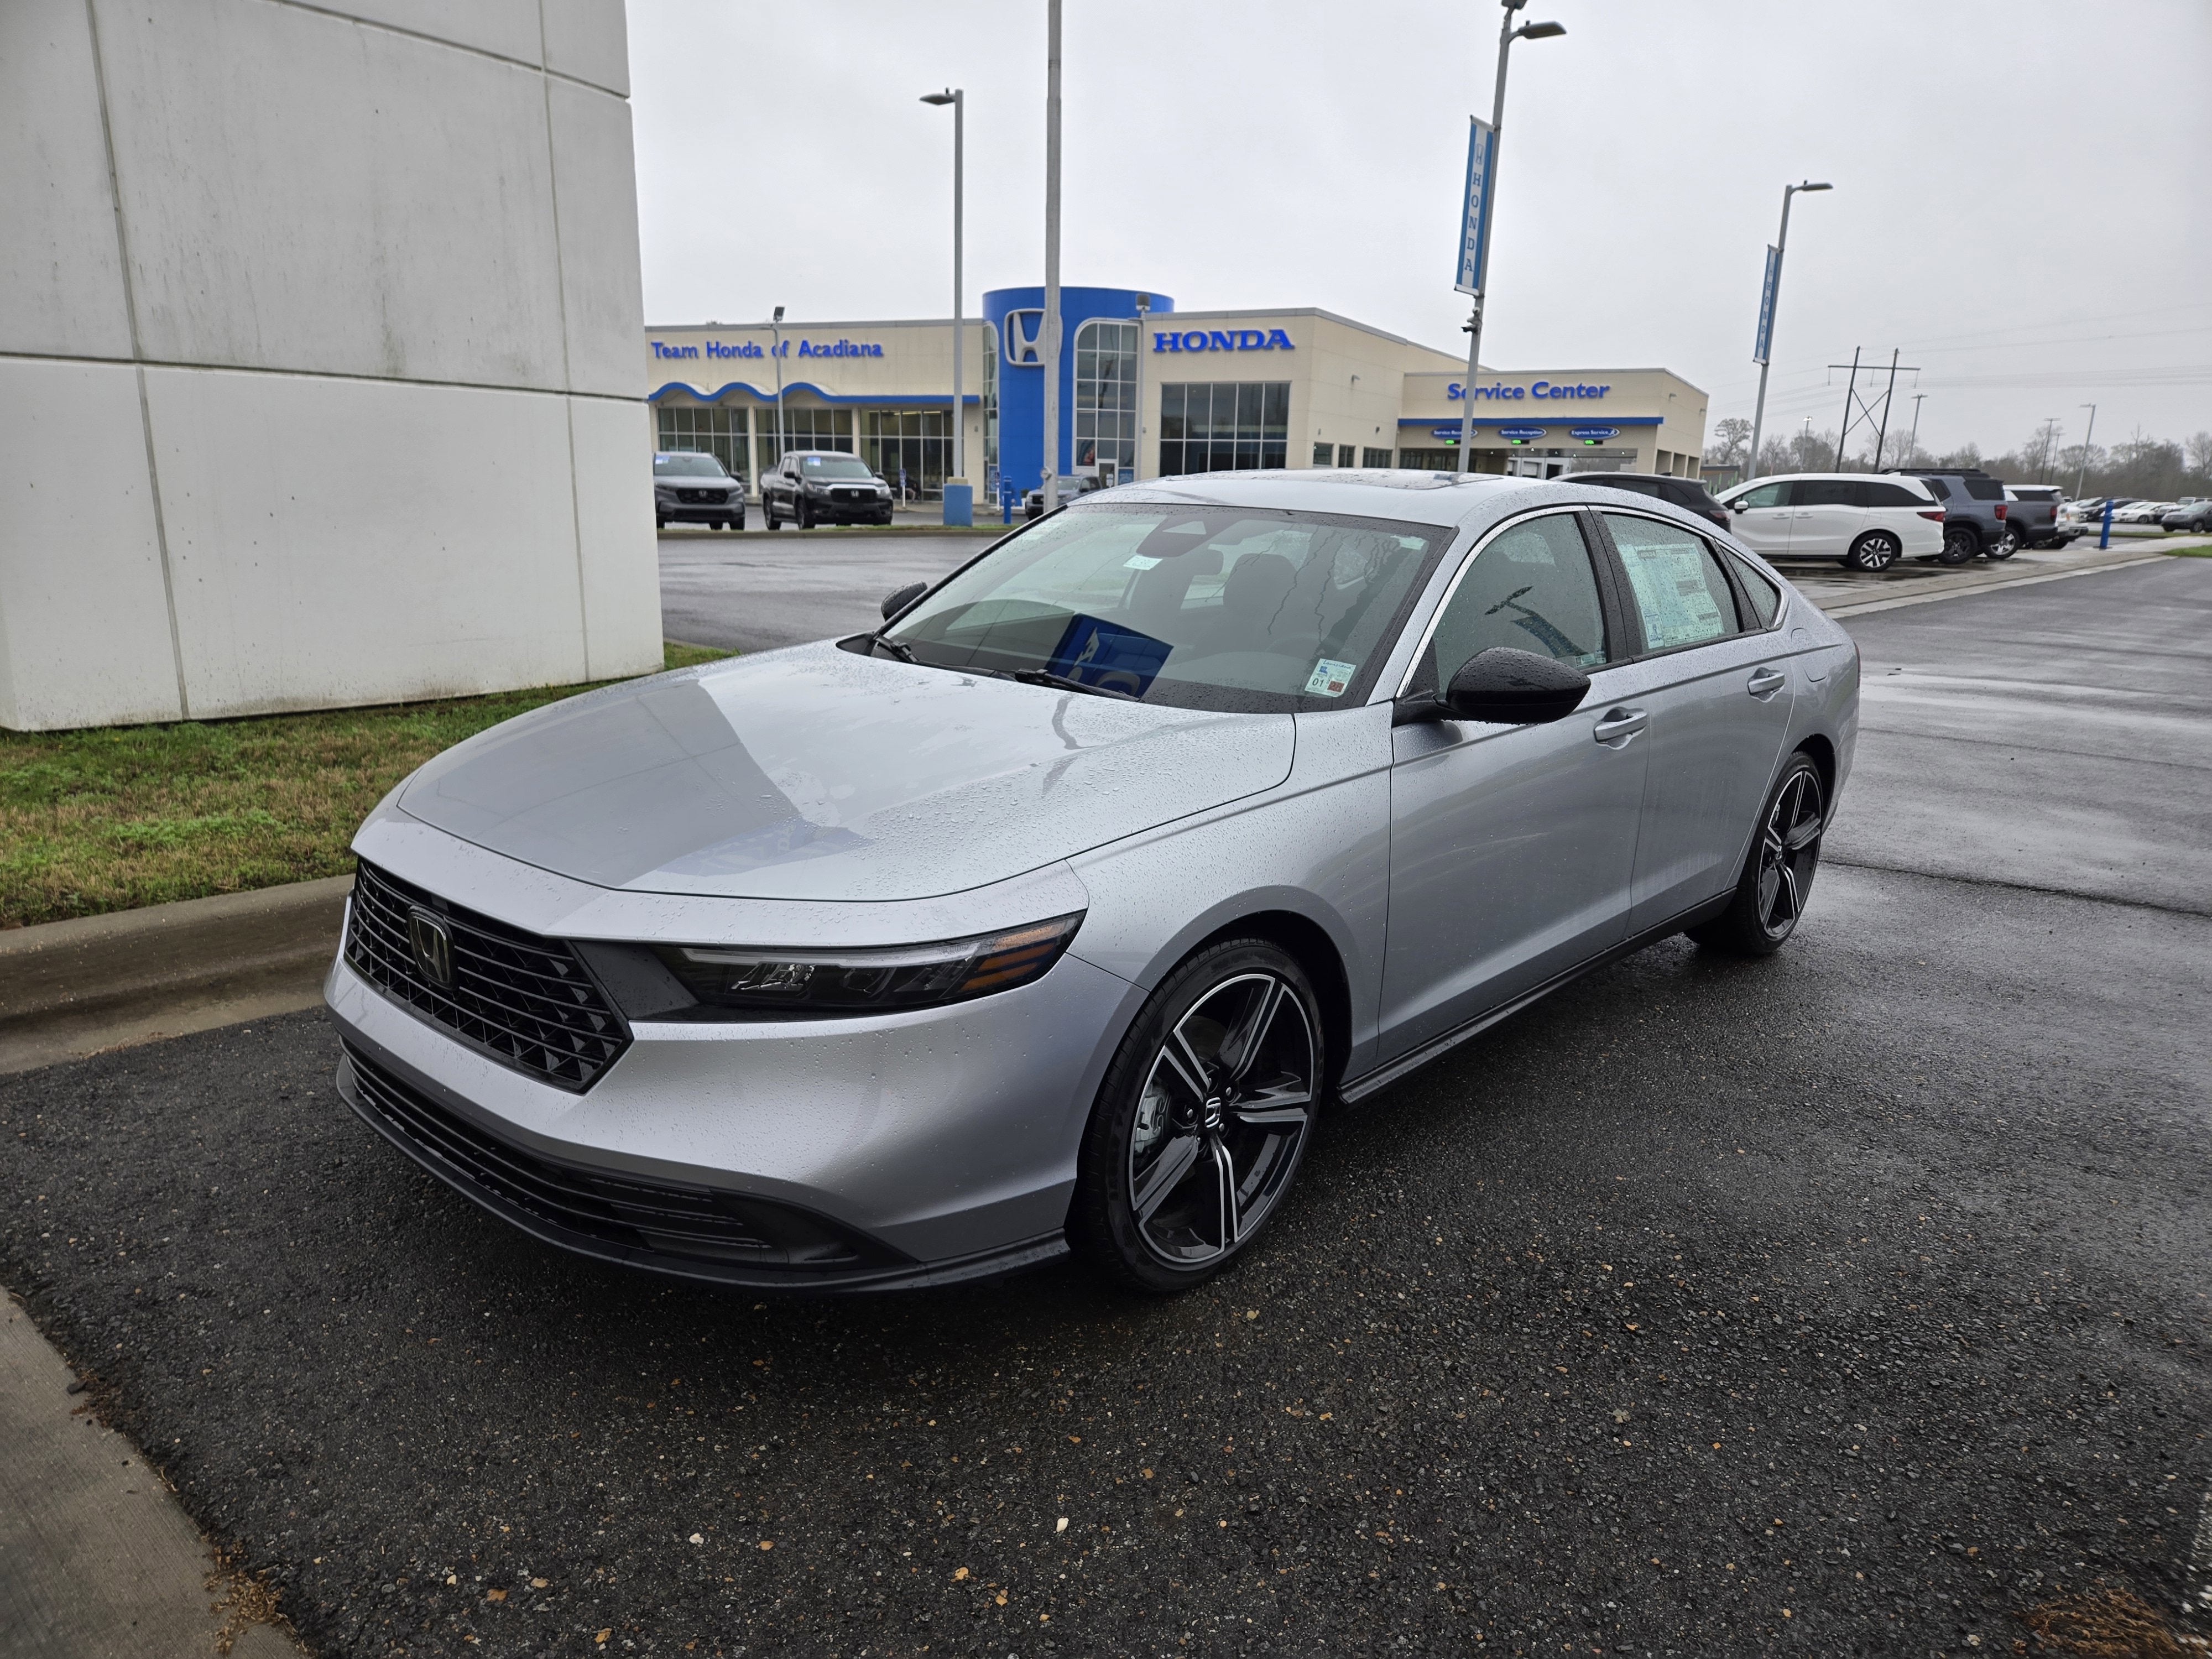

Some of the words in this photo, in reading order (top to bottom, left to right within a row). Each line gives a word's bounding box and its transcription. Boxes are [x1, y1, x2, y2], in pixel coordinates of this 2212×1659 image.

[1464, 173, 1481, 272] HONDA
[651, 341, 698, 358] Team
[706, 341, 763, 358] Honda
[771, 340, 789, 357] of
[798, 339, 884, 357] Acadiana
[1153, 329, 1295, 352] HONDA
[1531, 382, 1610, 399] Center
[1312, 678, 1324, 687] 01
